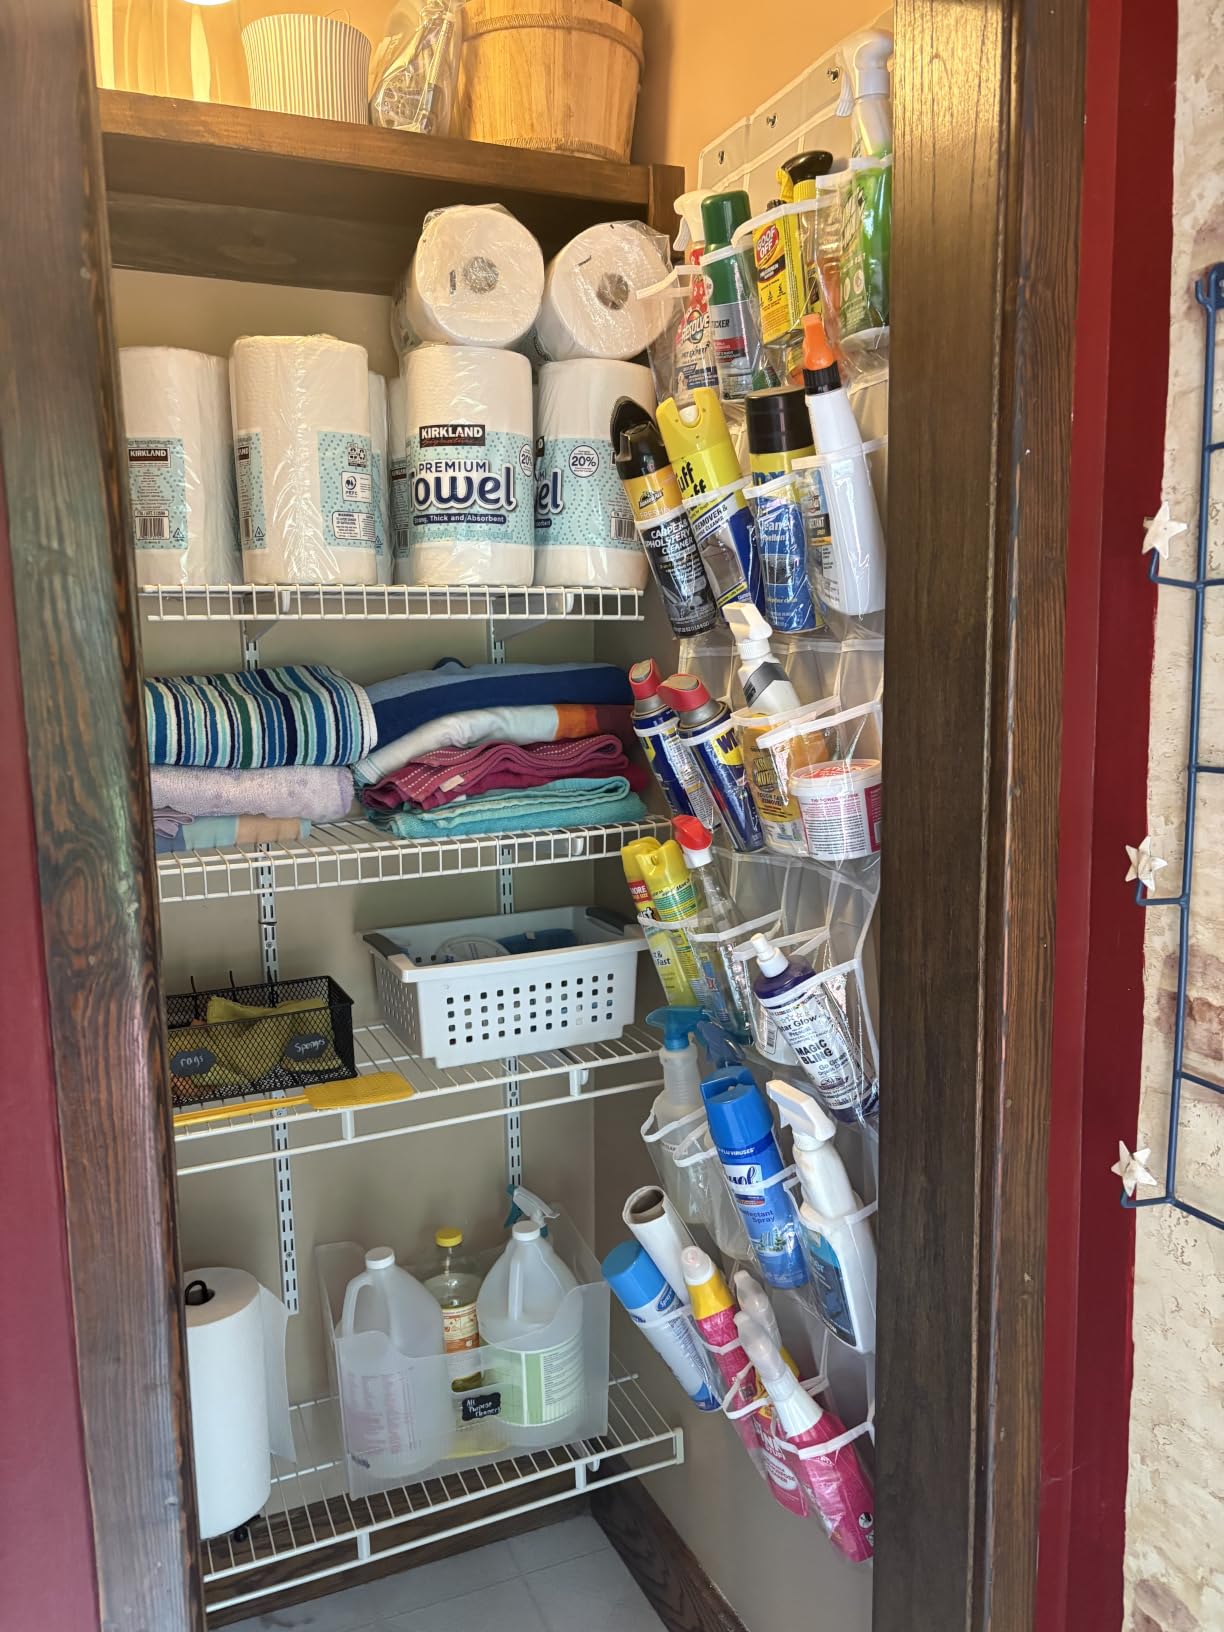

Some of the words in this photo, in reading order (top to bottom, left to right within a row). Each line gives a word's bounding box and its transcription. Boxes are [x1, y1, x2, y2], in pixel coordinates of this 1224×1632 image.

[760, 241, 774, 258] OFF
[421, 427, 483, 439] KIRKLAND
[419, 461, 487, 473] PREMIUM
[571, 456, 597, 467] 20%
[721, 504, 728, 513] &
[646, 529, 692, 549] PHOLSTERY
[662, 537, 694, 555] CLEANER
[793, 1015, 817, 1028] Glow
[795, 1039, 828, 1056] MAGIC
[180, 1055, 204, 1067] rags
[801, 1048, 833, 1065] BLING
[752, 1215, 775, 1223] Spray
[466, 1399, 476, 1407] All
